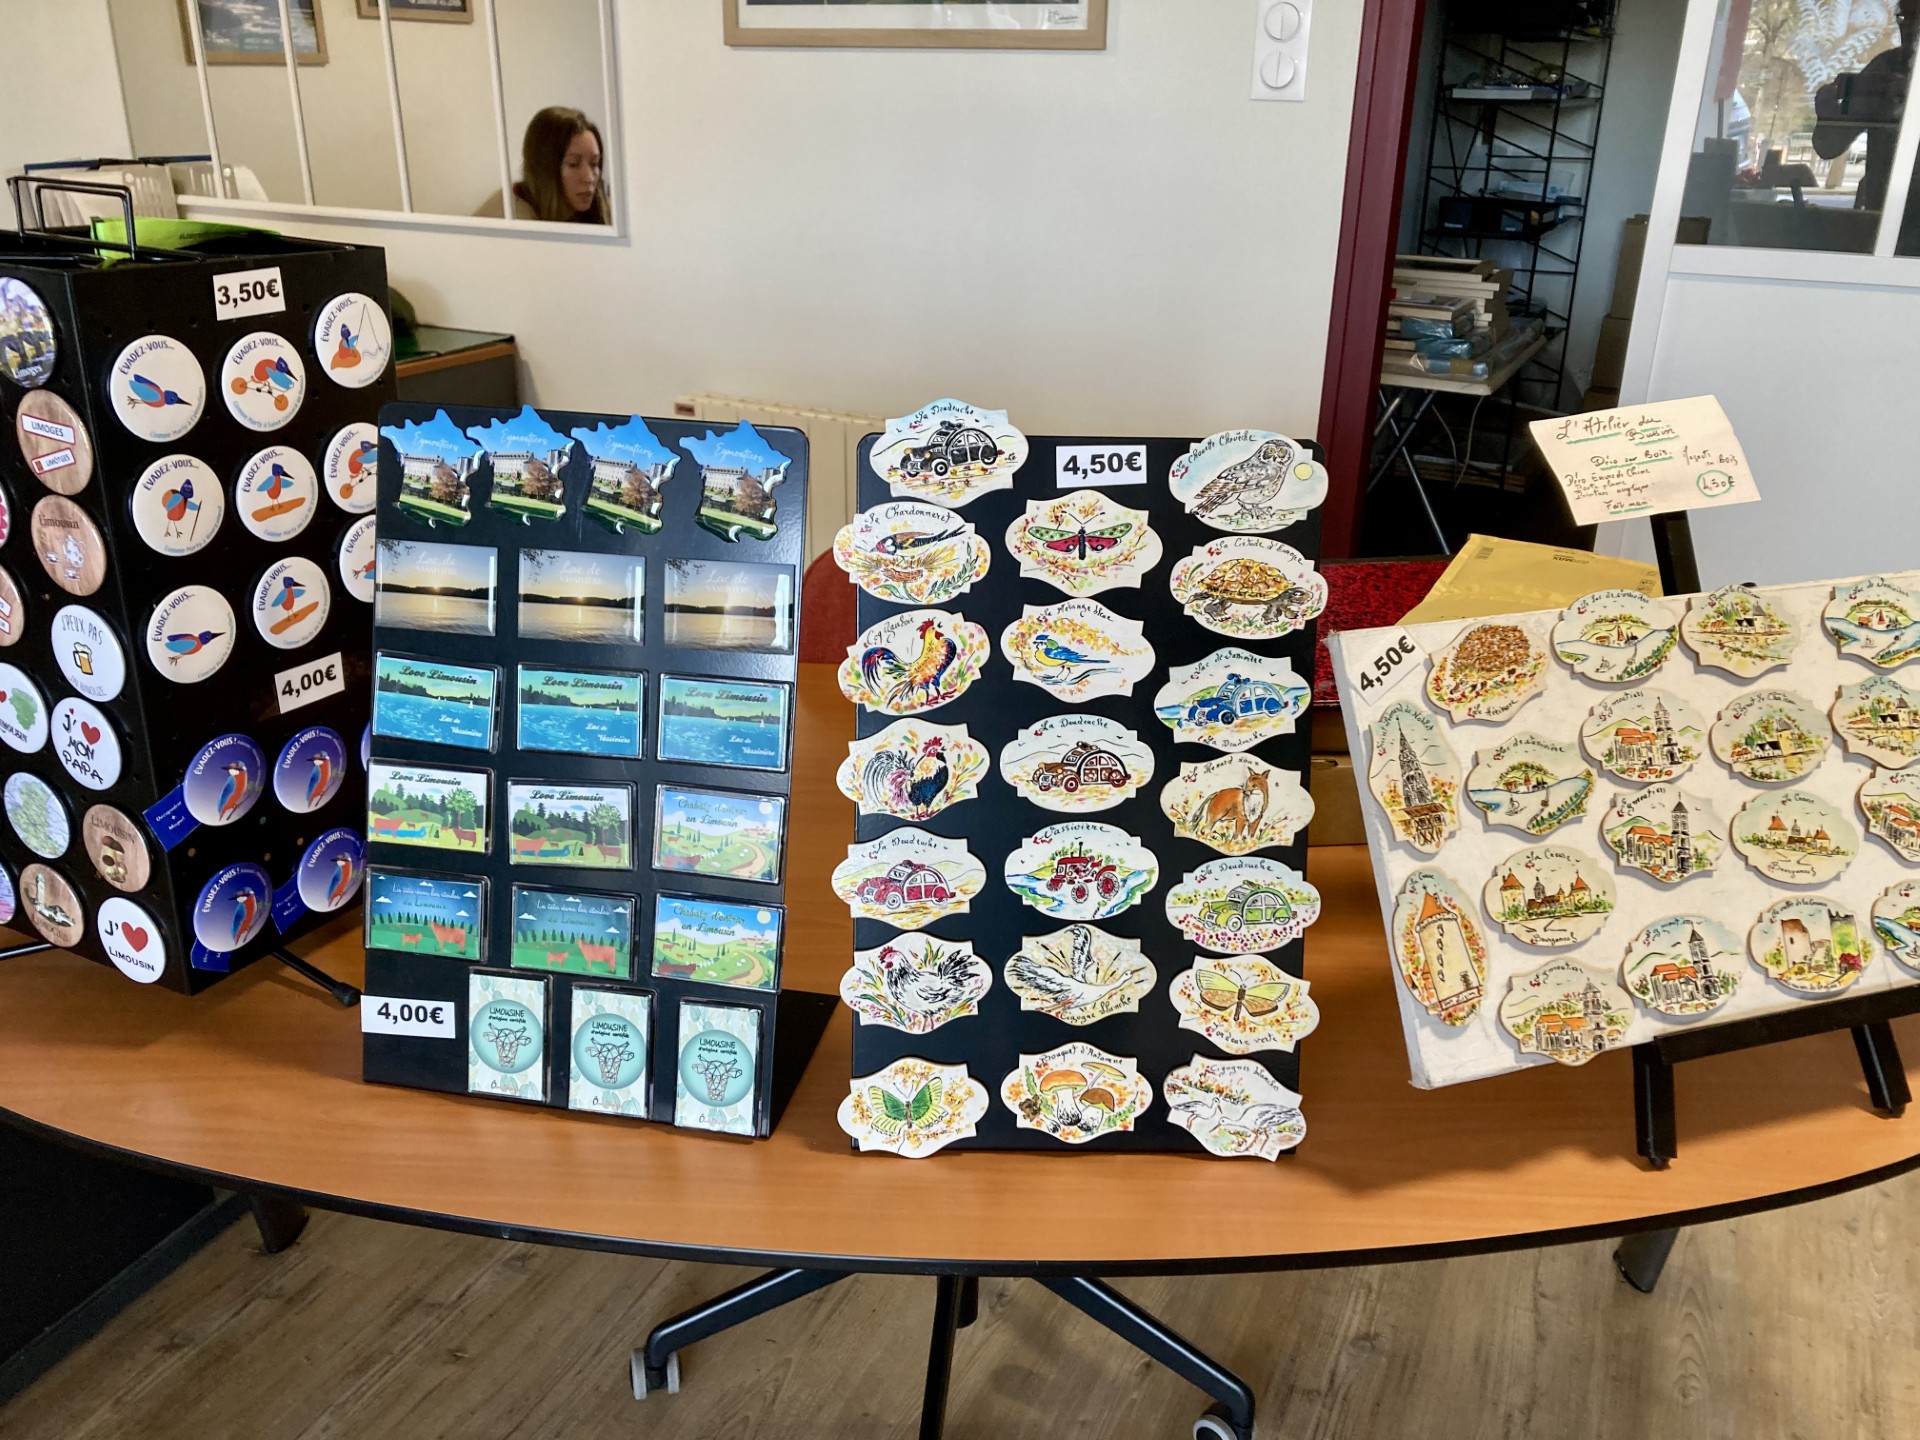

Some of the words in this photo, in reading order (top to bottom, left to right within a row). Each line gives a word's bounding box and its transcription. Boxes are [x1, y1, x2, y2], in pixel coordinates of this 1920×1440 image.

[217, 279, 280, 308] 3,50€
[31, 420, 65, 438] LIMOGES
[1062, 451, 1143, 480] 4,50€
[38, 514, 80, 529] Limousin
[884, 503, 955, 523] Chardonneret
[89, 622, 104, 645] PAS
[1359, 634, 1417, 693] 4,50€
[281, 664, 337, 697] 4,00€
[398, 664, 426, 678] Love
[427, 668, 478, 685] Limousin
[541, 675, 569, 687] Love
[570, 677, 624, 690] Limousin
[684, 686, 713, 699] Love
[714, 688, 768, 703] Limousin
[68, 736, 95, 761] MON
[62, 751, 104, 785] PAPA
[389, 770, 414, 782] Love
[414, 774, 462, 787] Limousin
[529, 789, 555, 800] Love
[556, 790, 605, 802] Limousin
[104, 919, 119, 936] J'
[681, 922, 693, 931] en
[696, 921, 736, 937] Limousin
[108, 946, 155, 973] LIMOUSIN
[377, 1002, 444, 1025] 4,00€
[489, 1007, 525, 1018] LIMOUSINE
[592, 1021, 628, 1033] LIMOUSINE
[699, 1037, 736, 1050] LIMOUSINE
